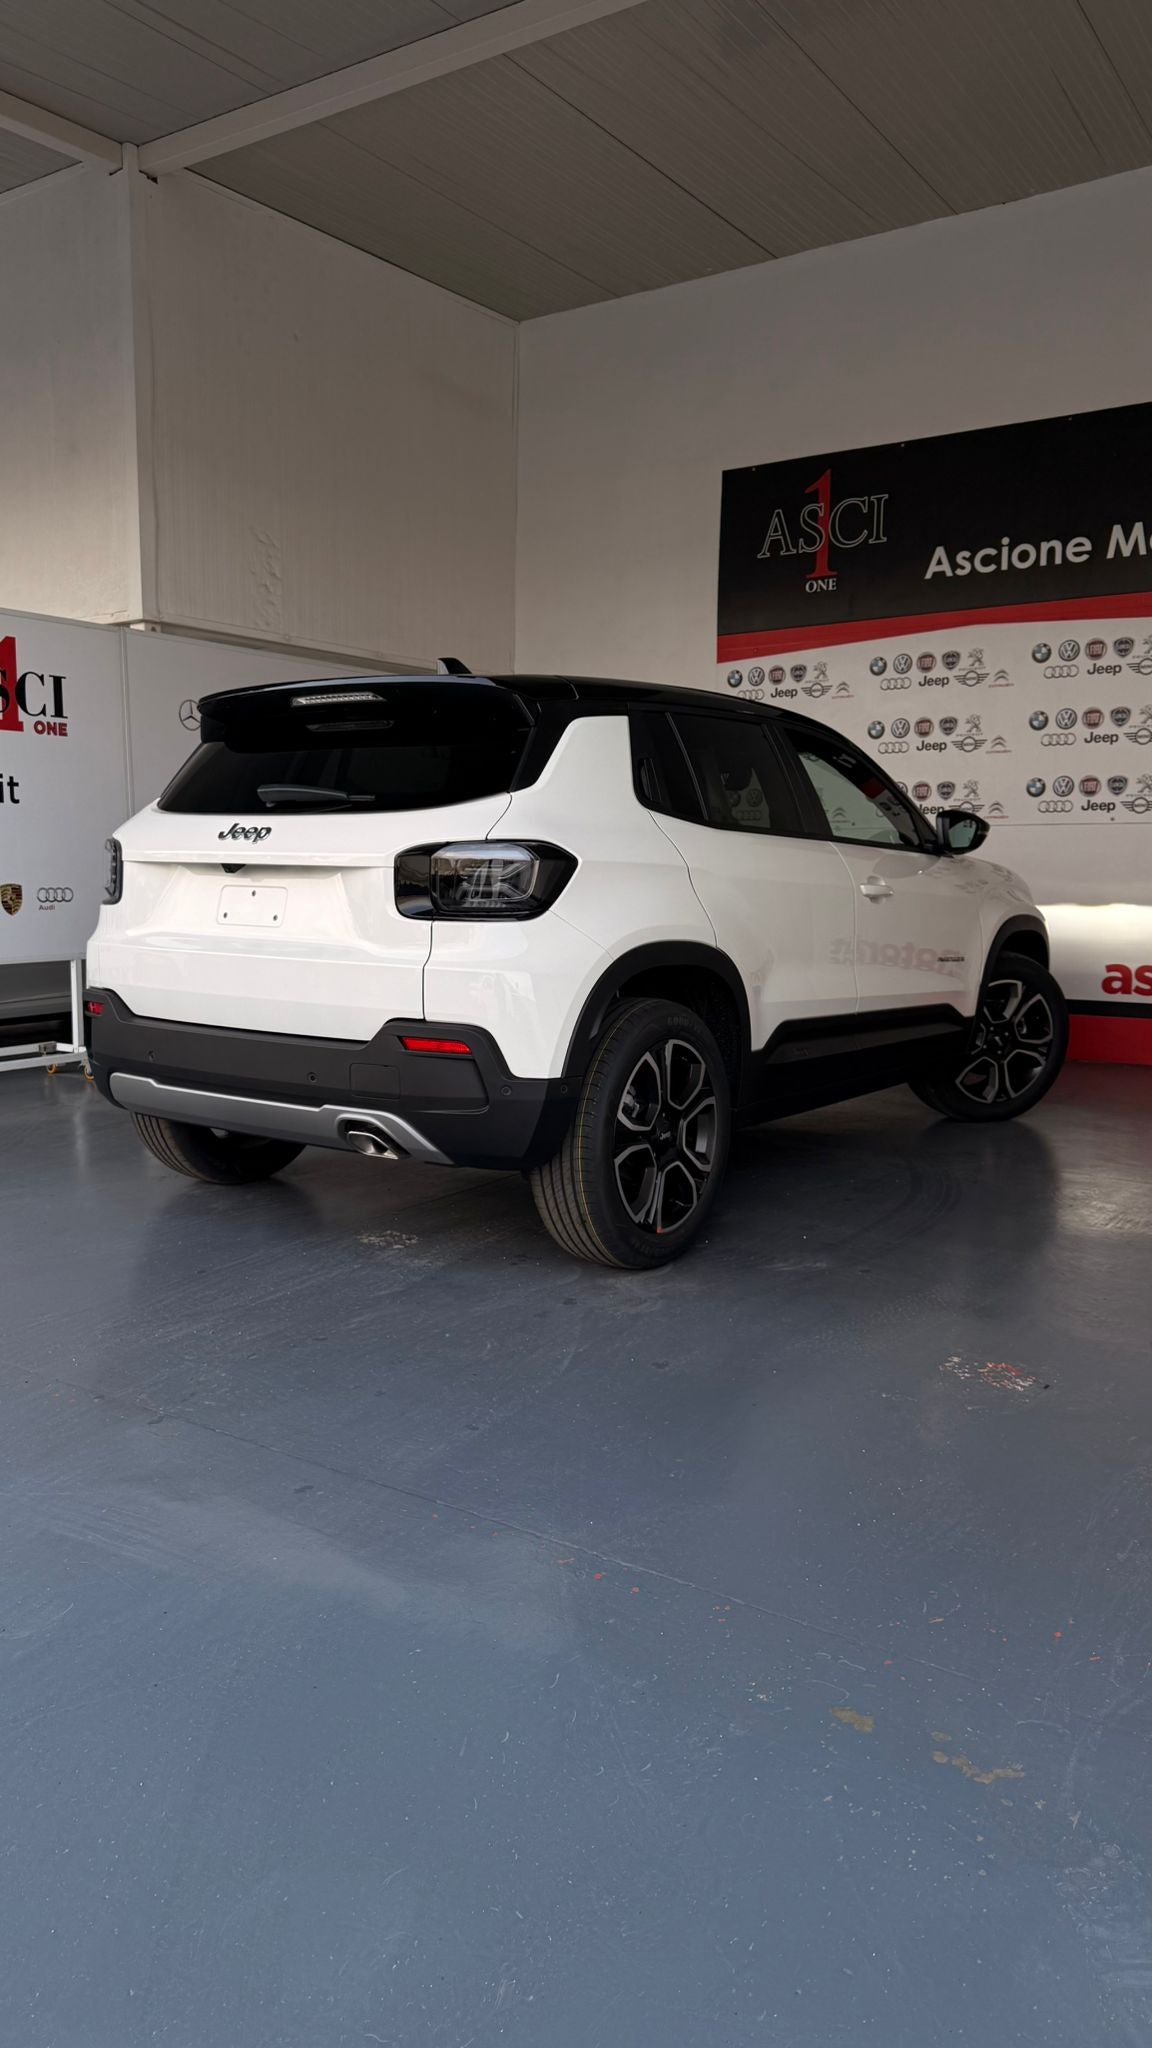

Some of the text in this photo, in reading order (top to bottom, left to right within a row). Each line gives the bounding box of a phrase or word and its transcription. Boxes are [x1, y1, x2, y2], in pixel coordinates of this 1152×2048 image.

[757, 494, 889, 559] ASCI
[923, 521, 1152, 580] Ascione M
[805, 578, 837, 593] ONE
[1087, 663, 1122, 676] Jeep
[918, 675, 950, 688] Jeep
[770, 687, 798, 699] Jeep
[33, 720, 68, 737] ONE
[1084, 731, 1119, 745] Jeep
[916, 740, 947, 752] Jeep
[1081, 800, 1116, 813] Jeep
[218, 823, 272, 844] Jeep
[1101, 963, 1152, 996] as
